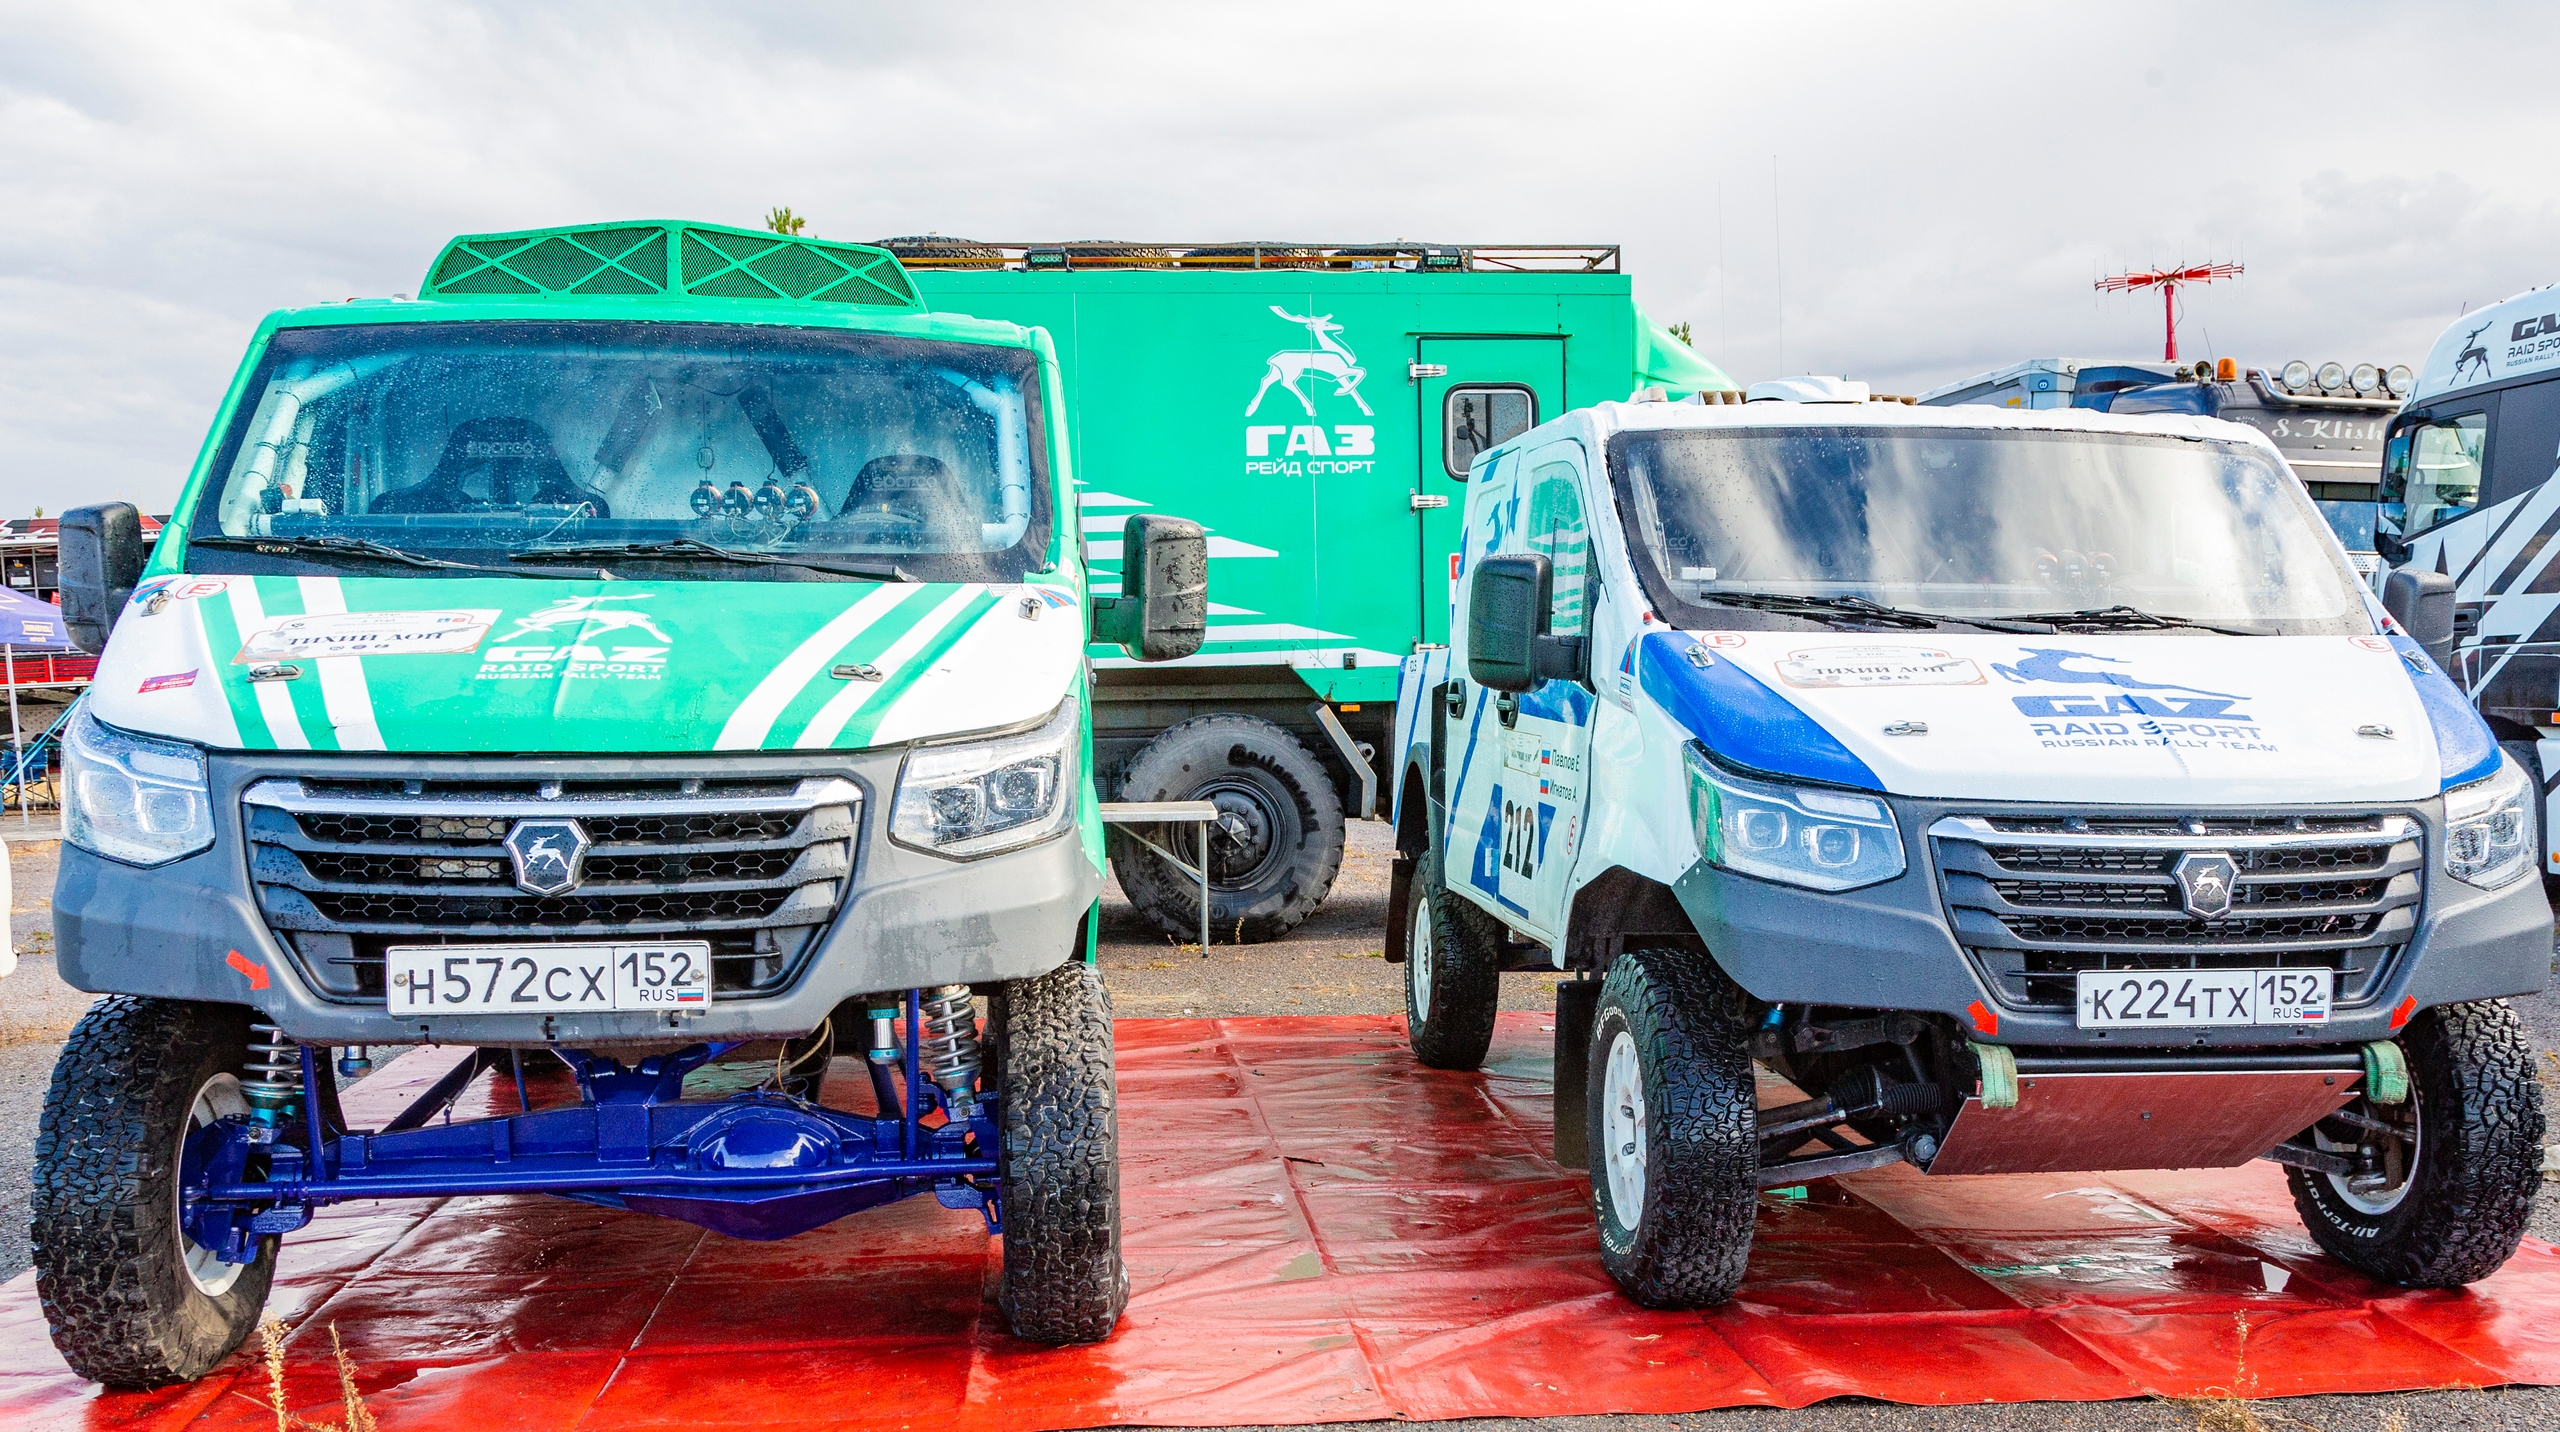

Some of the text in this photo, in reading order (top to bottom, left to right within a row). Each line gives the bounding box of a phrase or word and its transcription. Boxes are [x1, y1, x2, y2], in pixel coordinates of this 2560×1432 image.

[2510, 312, 2560, 343] GA
[2507, 342, 2535, 359] RAID
[2505, 356, 2533, 368] RUSSIAN
[2534, 352, 2555, 362] RALLY
[1246, 424, 1375, 456] ГАЗ
[1245, 457, 1375, 477] РЕЙД СПОРТ
[871, 474, 938, 492] sparco
[187, 583, 218, 595] E
[287, 632, 377, 646] ТИХИЙ
[1714, 635, 1736, 646] E
[2358, 638, 2386, 650] E
[484, 645, 671, 662] GAZ
[475, 671, 662, 681] RUSSIAN RALLY TEAM
[479, 663, 665, 673] RAID SPORT
[1812, 664, 1891, 675] ТИХИЙ
[2011, 694, 2254, 721] GAZ
[2030, 721, 2263, 739] RAID SPORT
[2041, 737, 2279, 753] RUSSIAN RALLY TEAM
[1551, 749, 1576, 771] Павлов
[1549, 779, 1572, 801] Игнатов
[1503, 799, 1534, 881] 212
[619, 952, 692, 987] 152
[639, 989, 675, 1002] RUS
[2260, 974, 2318, 1005] 152
[2273, 1007, 2302, 1019] RUS
[1596, 1006, 1634, 1041] BFGood
